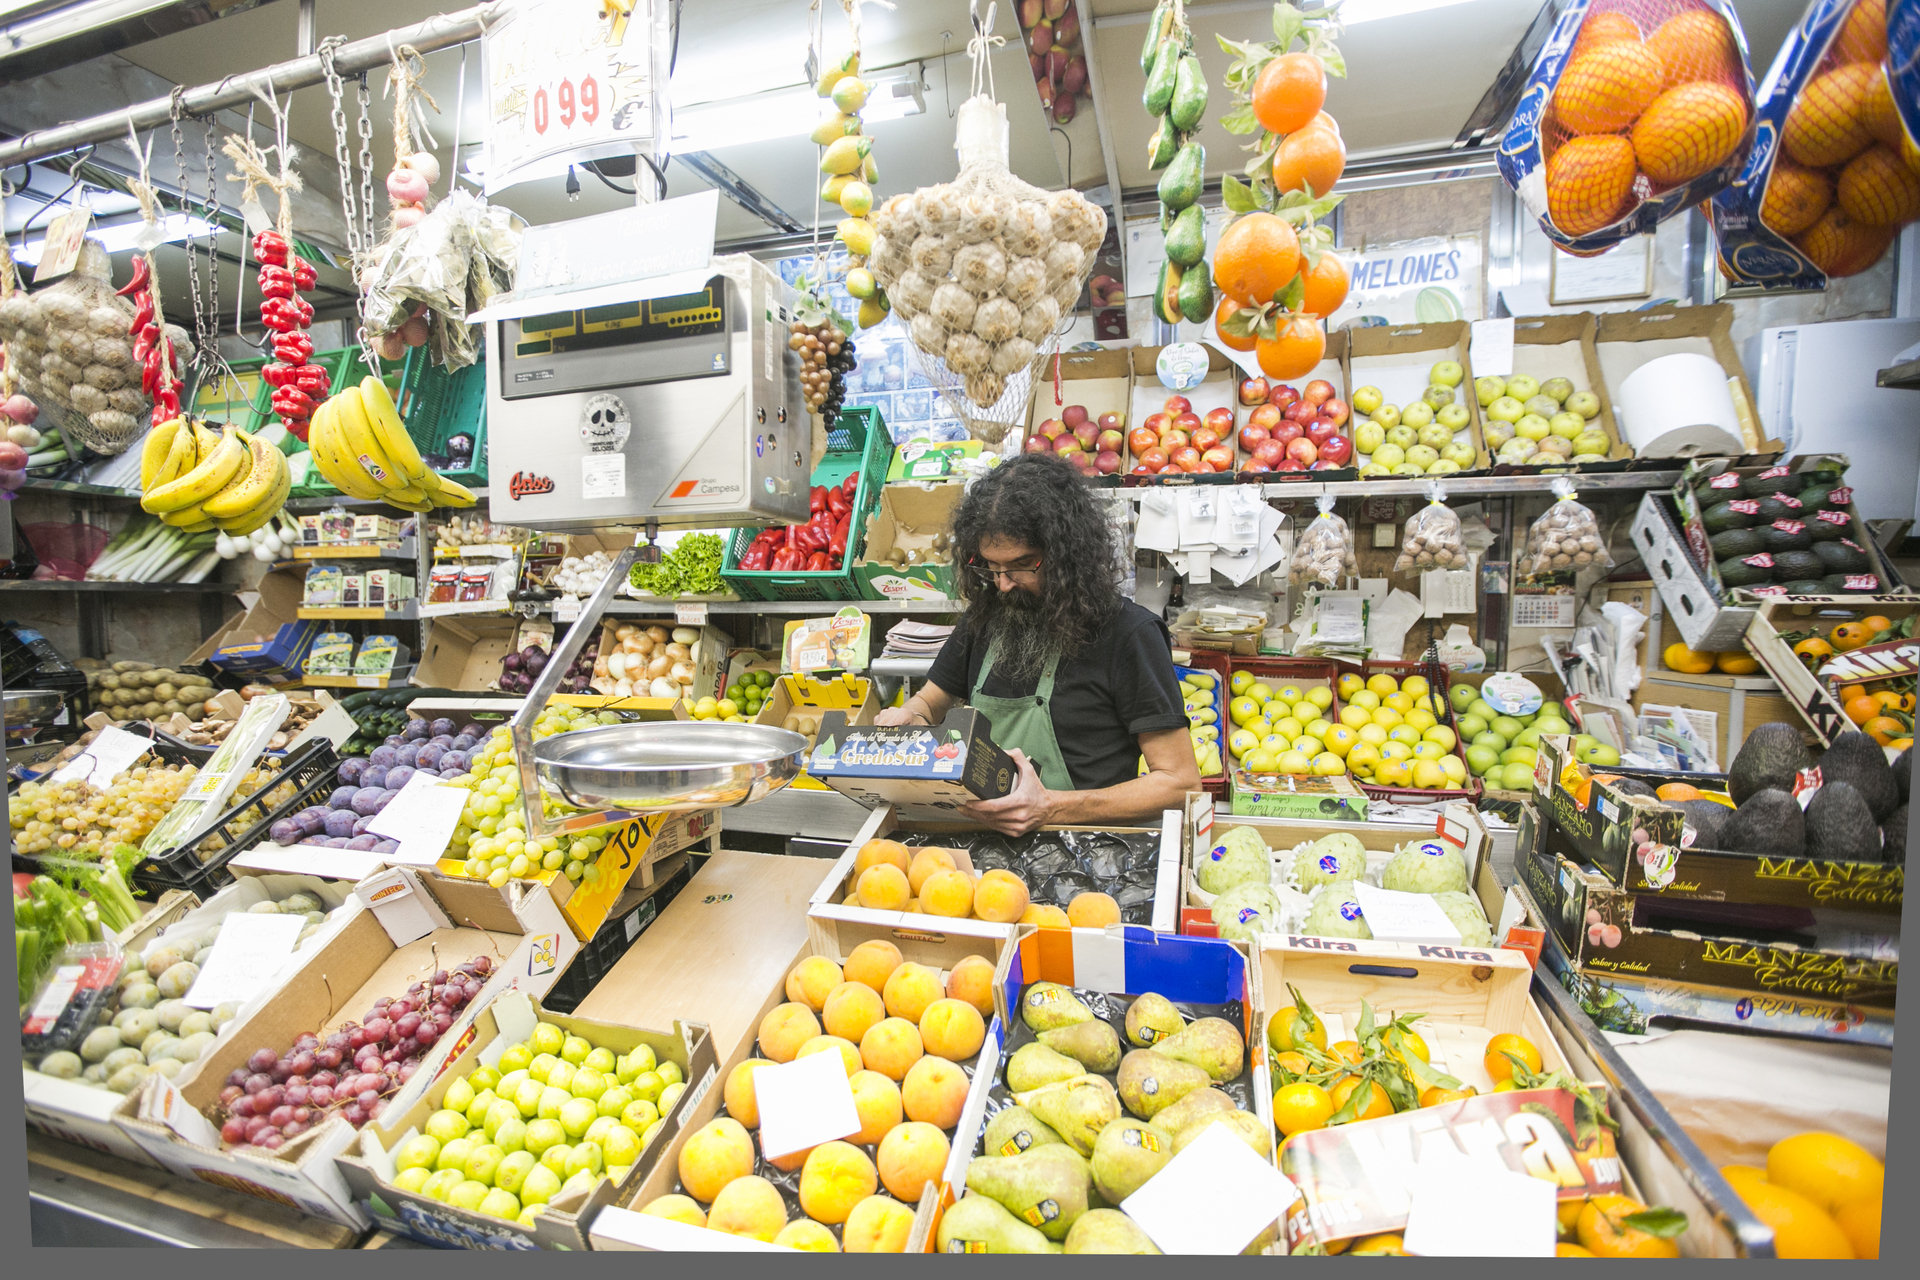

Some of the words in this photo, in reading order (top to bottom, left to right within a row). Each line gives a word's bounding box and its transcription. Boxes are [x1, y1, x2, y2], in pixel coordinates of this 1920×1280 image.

[611, 101, 645, 131] €
[617, 212, 670, 238] Tenemos
[580, 259, 626, 284] hierbas
[1350, 249, 1461, 292] MELONES
[701, 485, 740, 494] Campesa
[555, 603, 580, 611] Cebollas
[560, 611, 576, 620] rojas
[680, 616, 701, 624] dulces
[832, 617, 864, 629] Zespri
[841, 749, 929, 767] GredoSur
[1246, 804, 1269, 816] Valle
[1271, 806, 1287, 816] del
[1291, 807, 1317, 818] Sabor
[1669, 881, 1701, 892] Calidad
[1288, 936, 1358, 952] Kira
[1418, 945, 1494, 962] Kira
[1589, 957, 1612, 968] Sabor
[1619, 962, 1650, 972] Calidad
[1754, 966, 1858, 994] Exclusive
[1288, 1200, 1362, 1242] PEPINS
